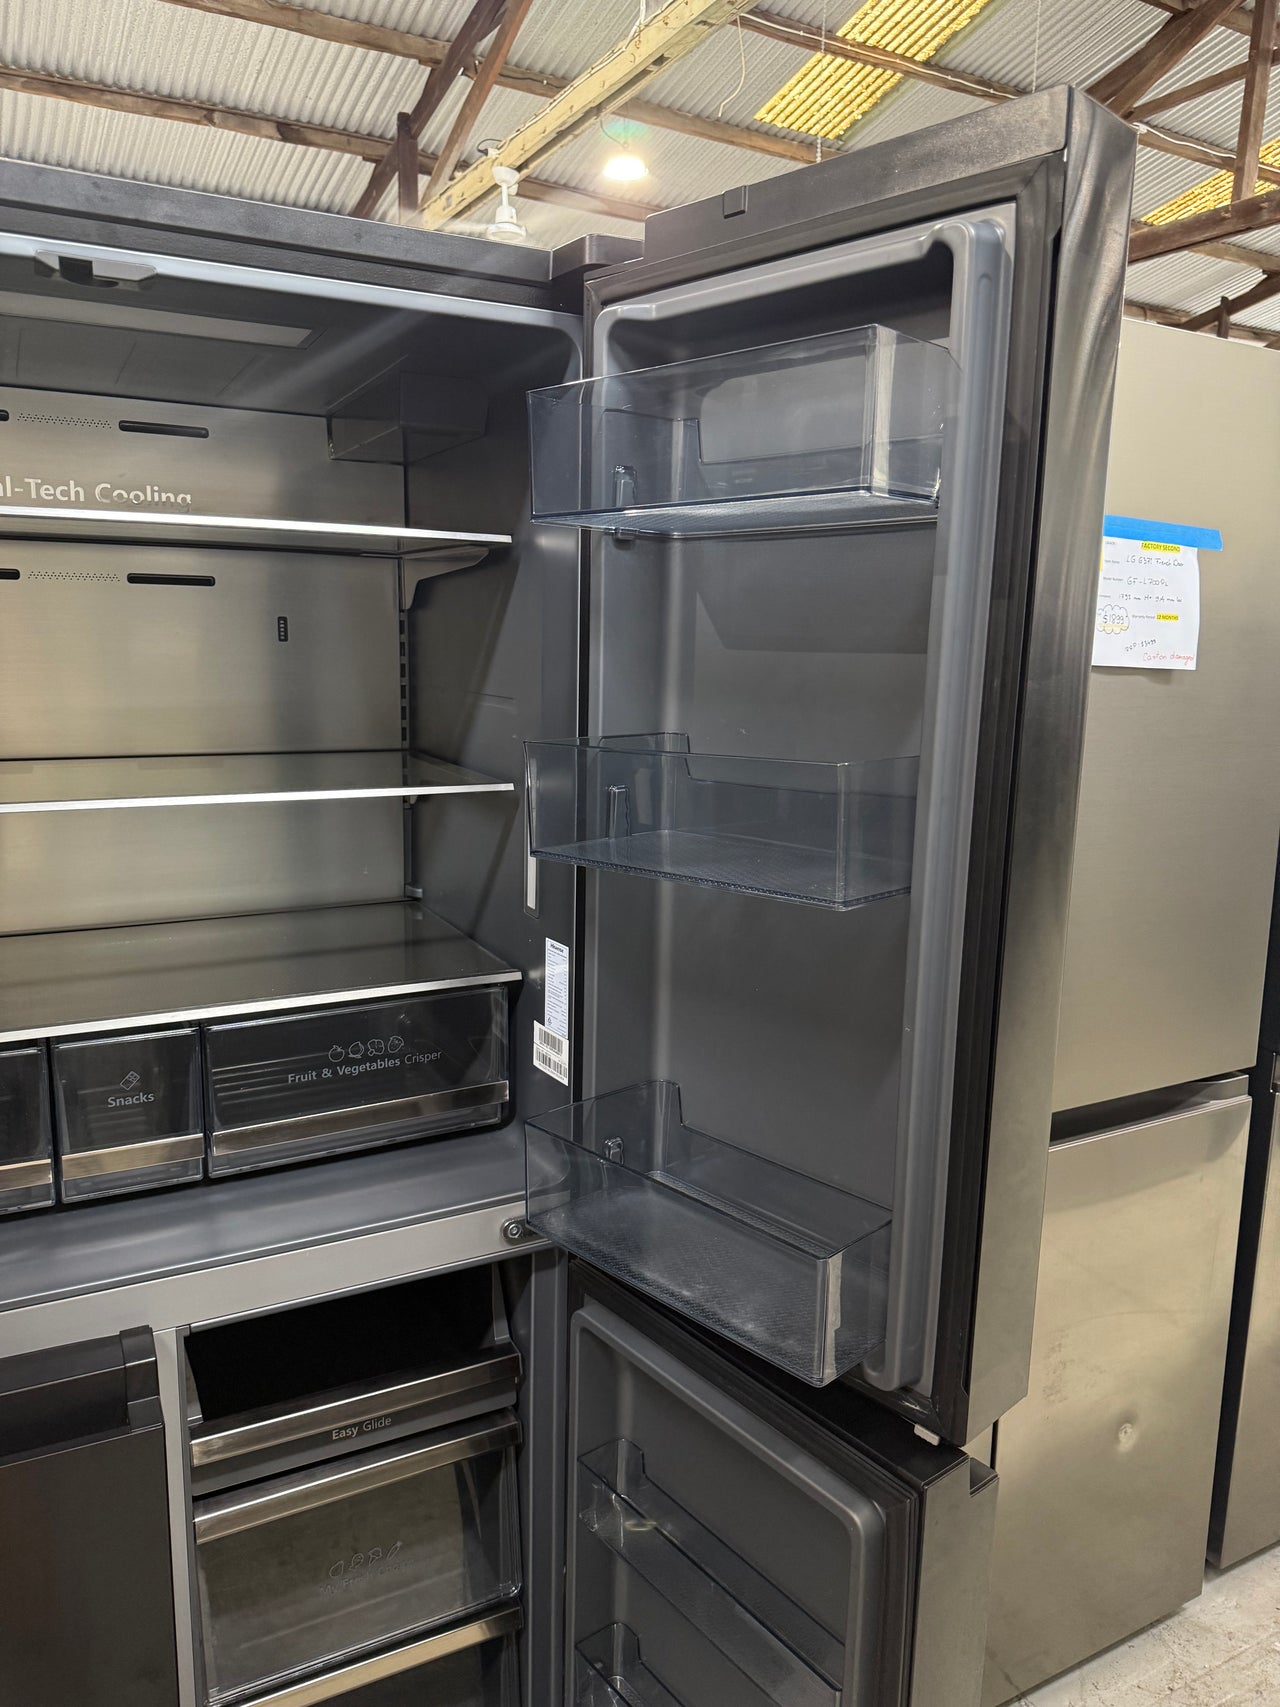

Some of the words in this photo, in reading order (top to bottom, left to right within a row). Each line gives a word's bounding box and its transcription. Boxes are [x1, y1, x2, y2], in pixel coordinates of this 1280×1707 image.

[0, 475, 85, 502] l-Tech
[94, 483, 192, 513] Cooling
[1141, 542, 1162, 551] FACTORY
[1162, 545, 1180, 553] SECOND
[1126, 555, 1136, 563] LG
[287, 1070, 317, 1085] Fruit
[321, 1067, 333, 1079] &
[336, 1056, 401, 1077] Vegetables
[404, 1049, 442, 1067] Crisper
[107, 1091, 155, 1108] Snacks
[332, 1425, 359, 1441] Easy
[362, 1416, 392, 1432] Glide
